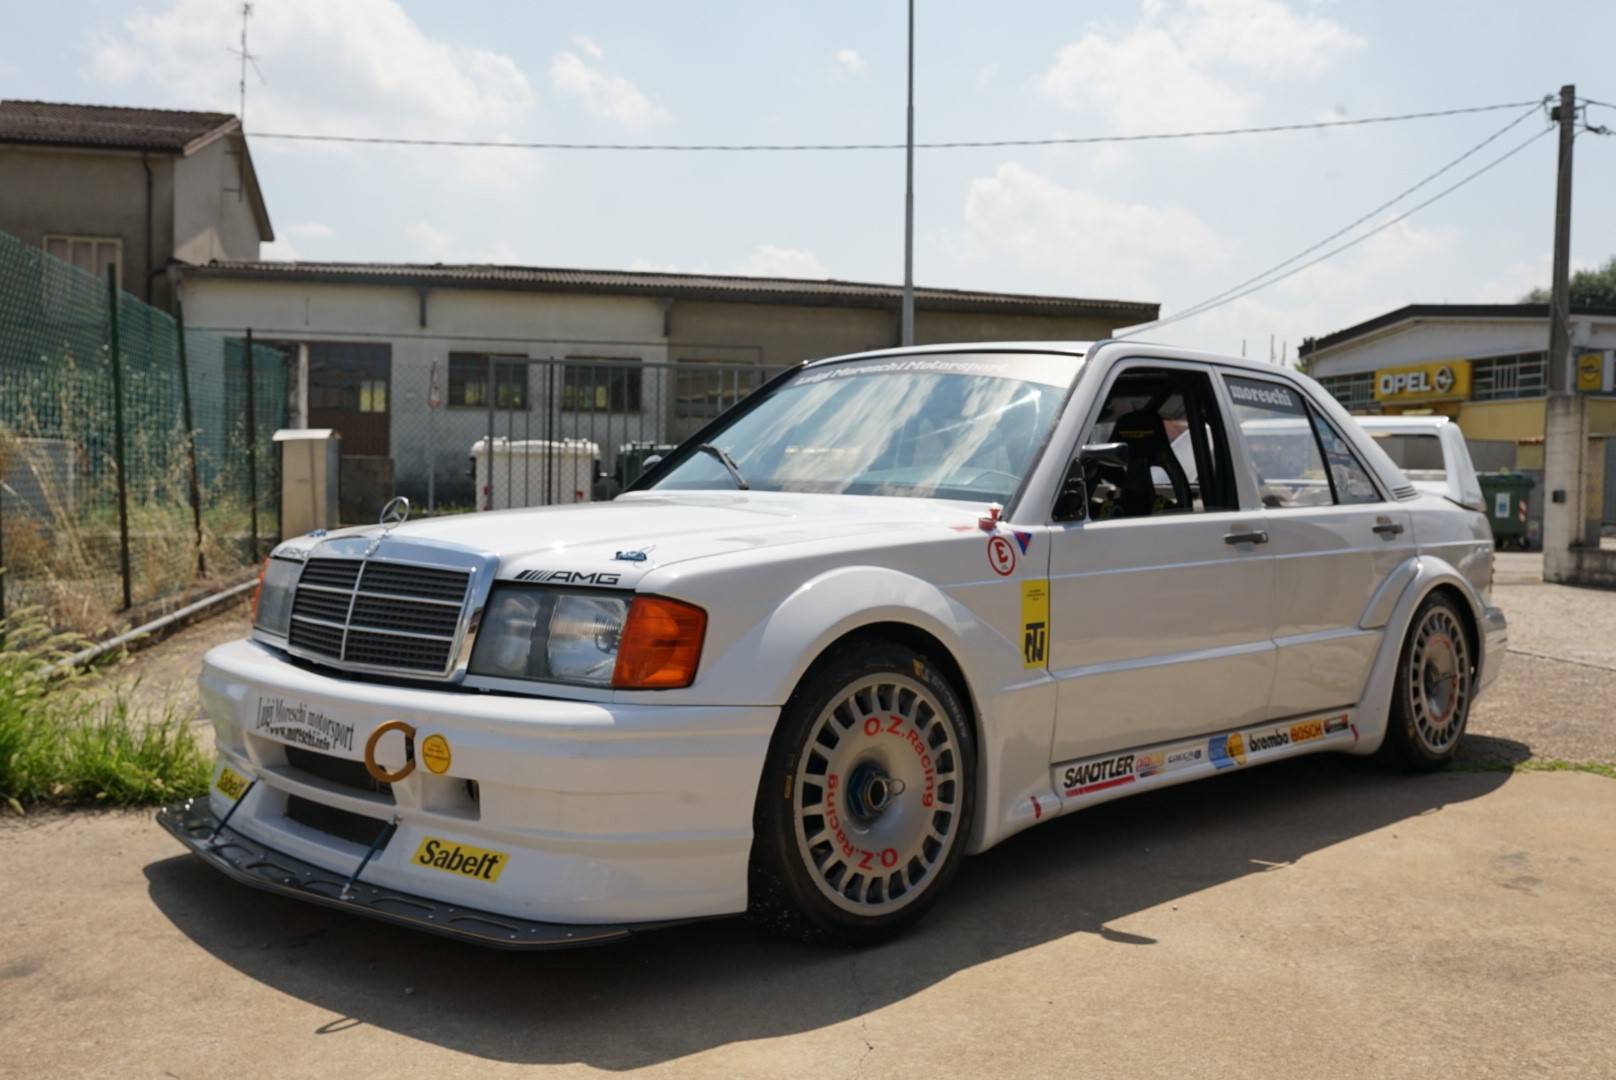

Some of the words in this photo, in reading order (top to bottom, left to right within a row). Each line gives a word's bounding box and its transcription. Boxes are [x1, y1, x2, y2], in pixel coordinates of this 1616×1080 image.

[1380, 371, 1431, 395] OPEL
[1229, 385, 1293, 407] moreschi
[994, 541, 1009, 564] E
[546, 570, 622, 585] AMG
[308, 711, 355, 752] motorsport
[1249, 729, 1290, 752] brembo
[1291, 722, 1324, 742] BOSCH
[419, 839, 502, 880] Sabelt
